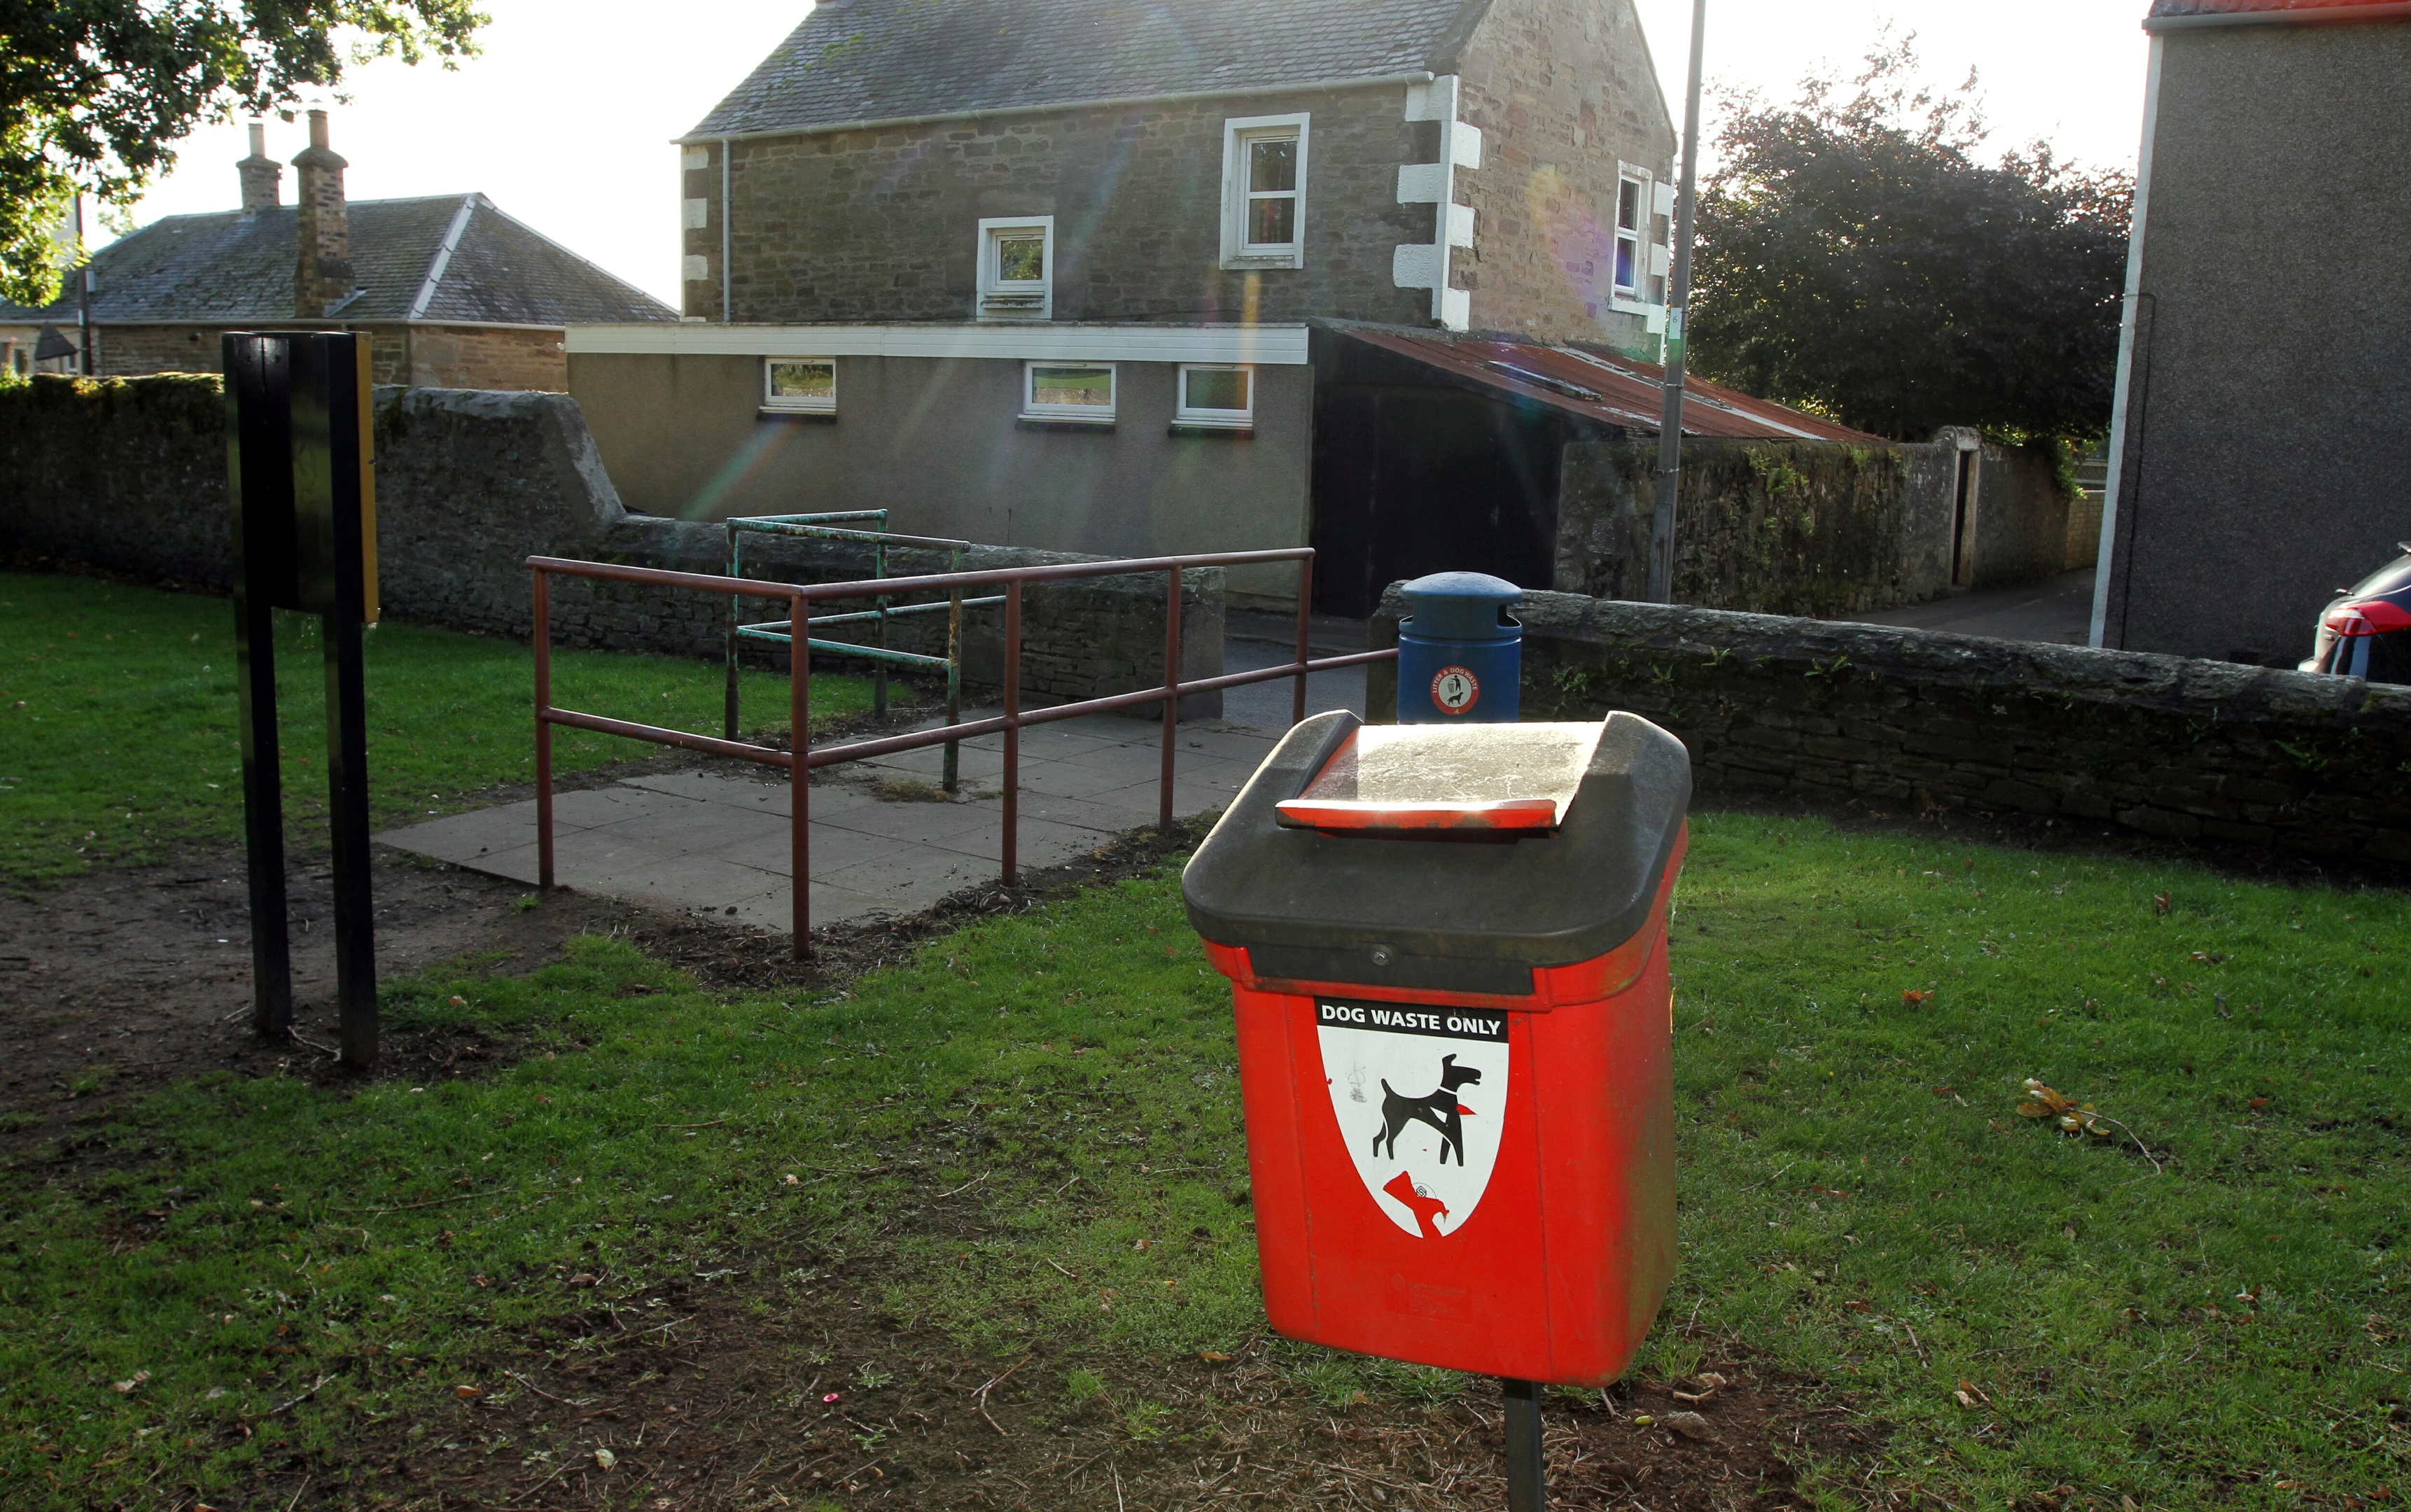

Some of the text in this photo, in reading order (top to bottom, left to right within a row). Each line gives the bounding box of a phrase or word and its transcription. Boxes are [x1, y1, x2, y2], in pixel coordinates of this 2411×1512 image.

[1432, 673, 1443, 693] LITTER
[1465, 671, 1478, 690] WASTE
[1321, 1004, 1502, 1035] DOG WASTE ONLY
